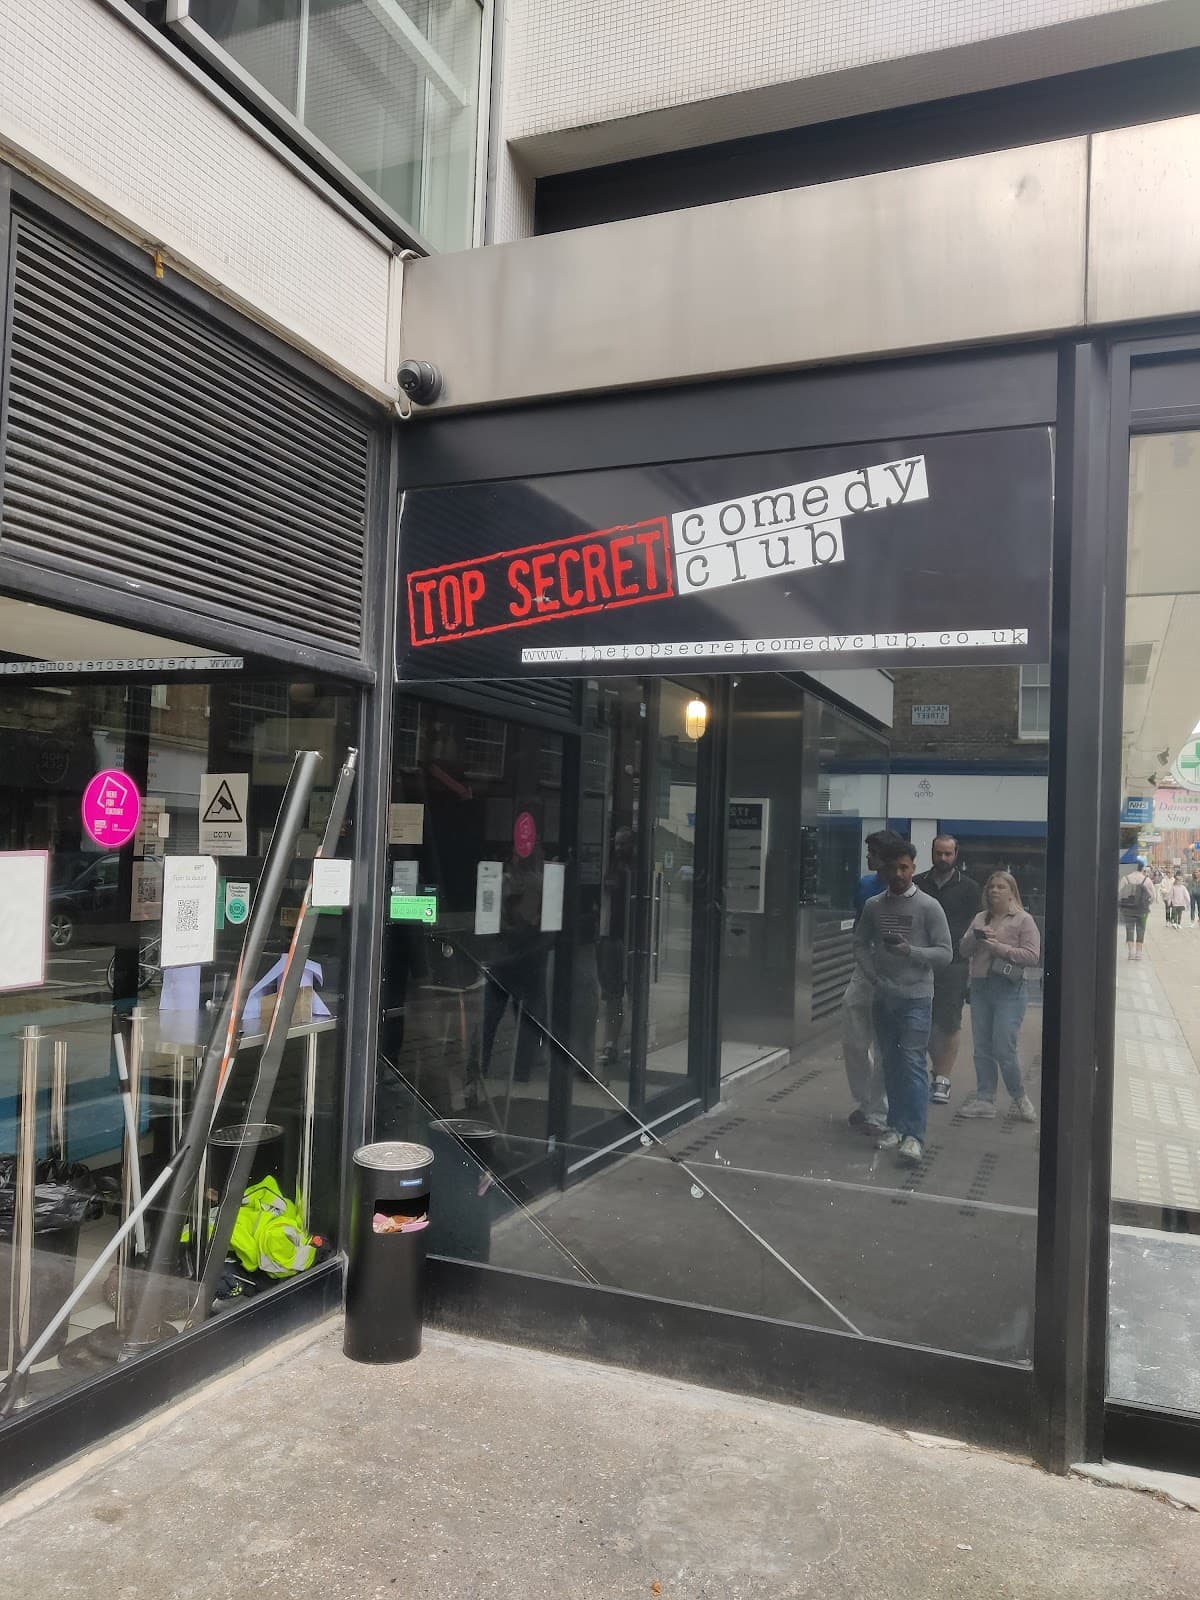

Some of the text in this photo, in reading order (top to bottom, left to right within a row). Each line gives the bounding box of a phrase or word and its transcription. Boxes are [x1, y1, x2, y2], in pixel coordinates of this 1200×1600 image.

[680, 456, 922, 547] comedy
[684, 520, 842, 588] club
[415, 530, 662, 635] TOP SECRET
[1129, 802, 1147, 810] NHS
[1167, 813, 1191, 825] Shop
[213, 831, 233, 839] CCTV
